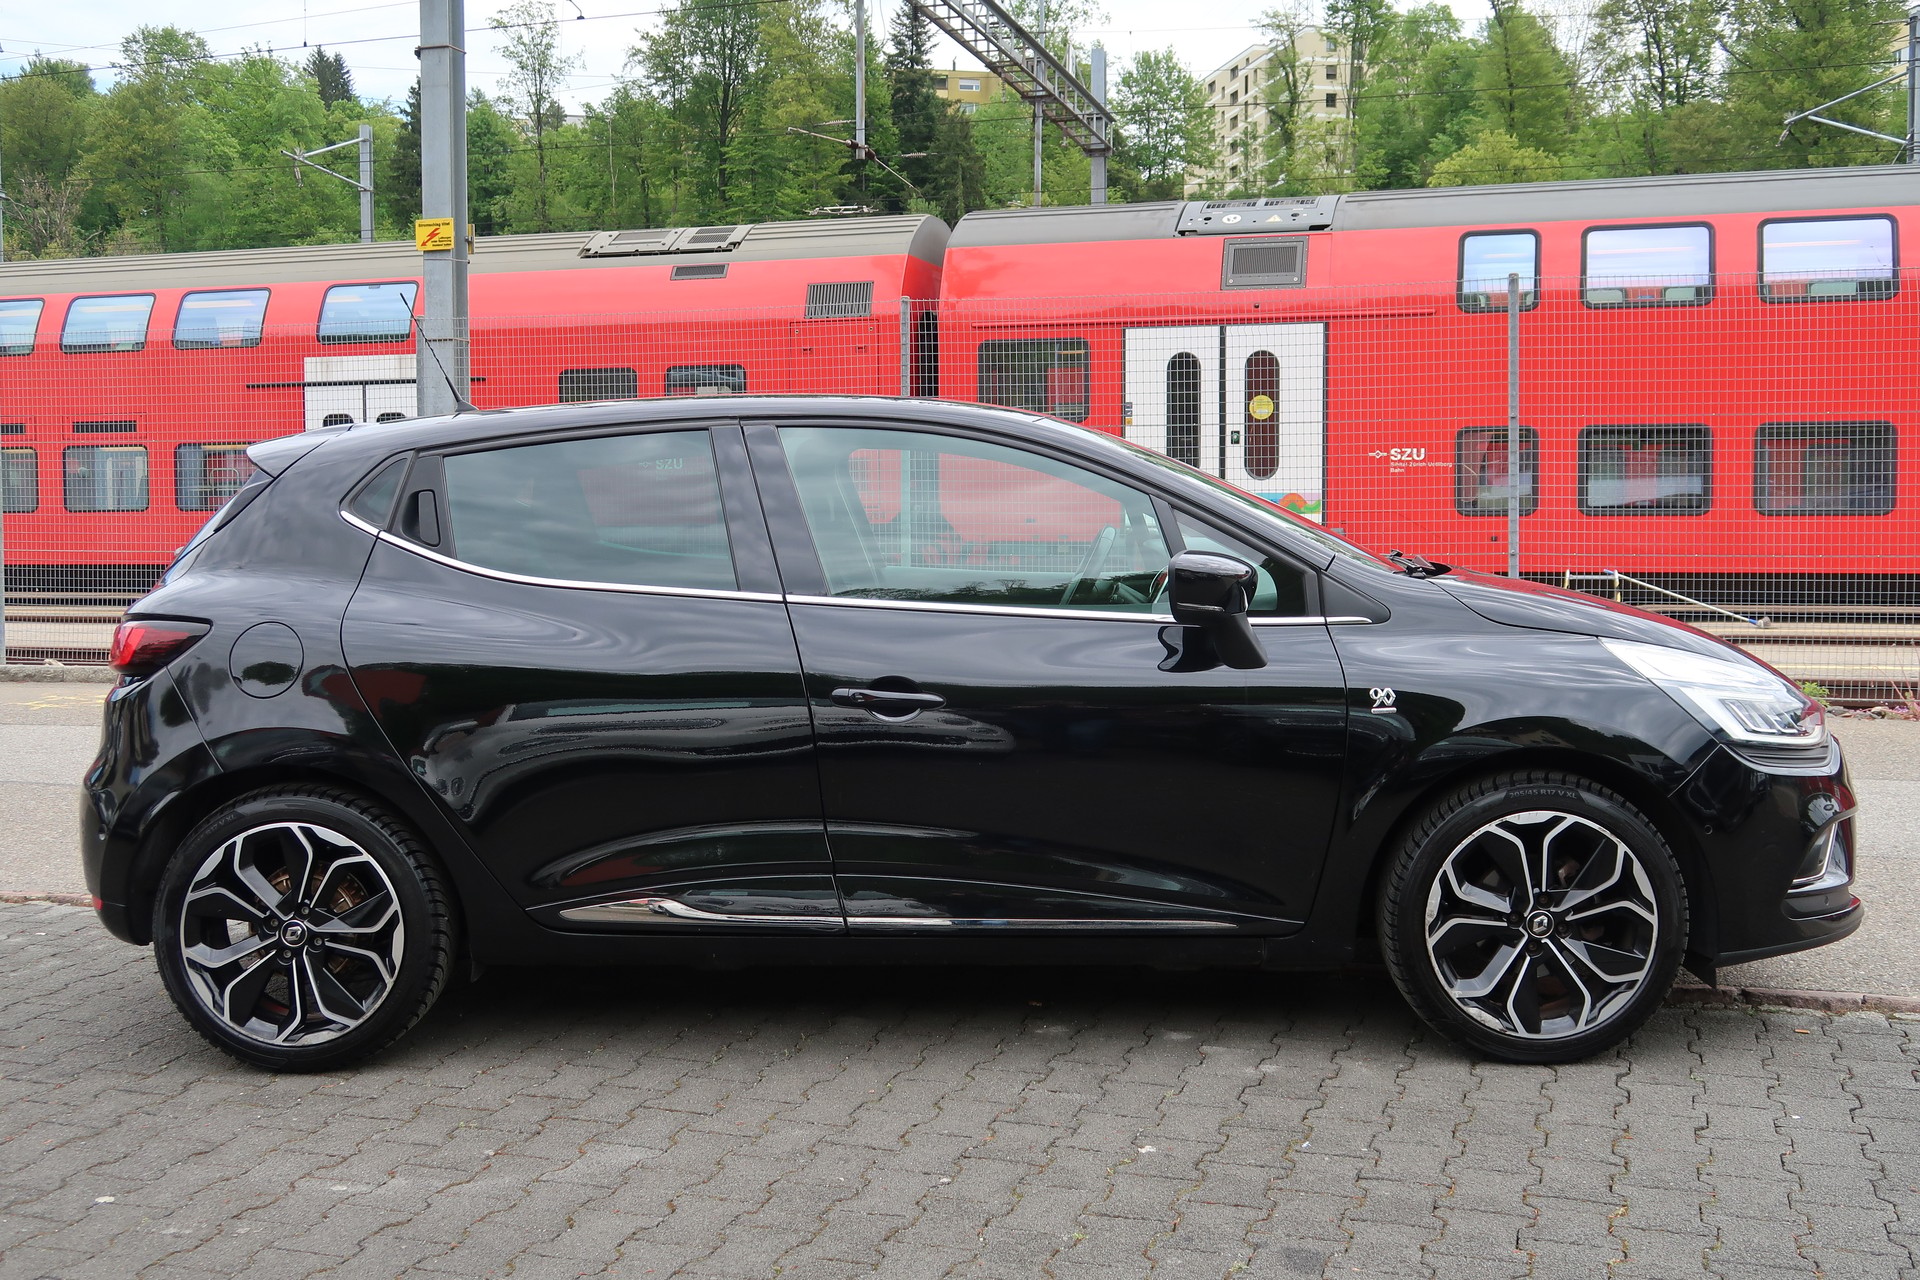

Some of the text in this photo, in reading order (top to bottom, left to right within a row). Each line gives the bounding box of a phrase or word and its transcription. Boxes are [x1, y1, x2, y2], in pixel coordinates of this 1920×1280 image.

[1390, 447, 1426, 461] SZU
[656, 458, 683, 470] SZU
[1509, 789, 1539, 799] 205/45
[1566, 791, 1577, 799] XL
